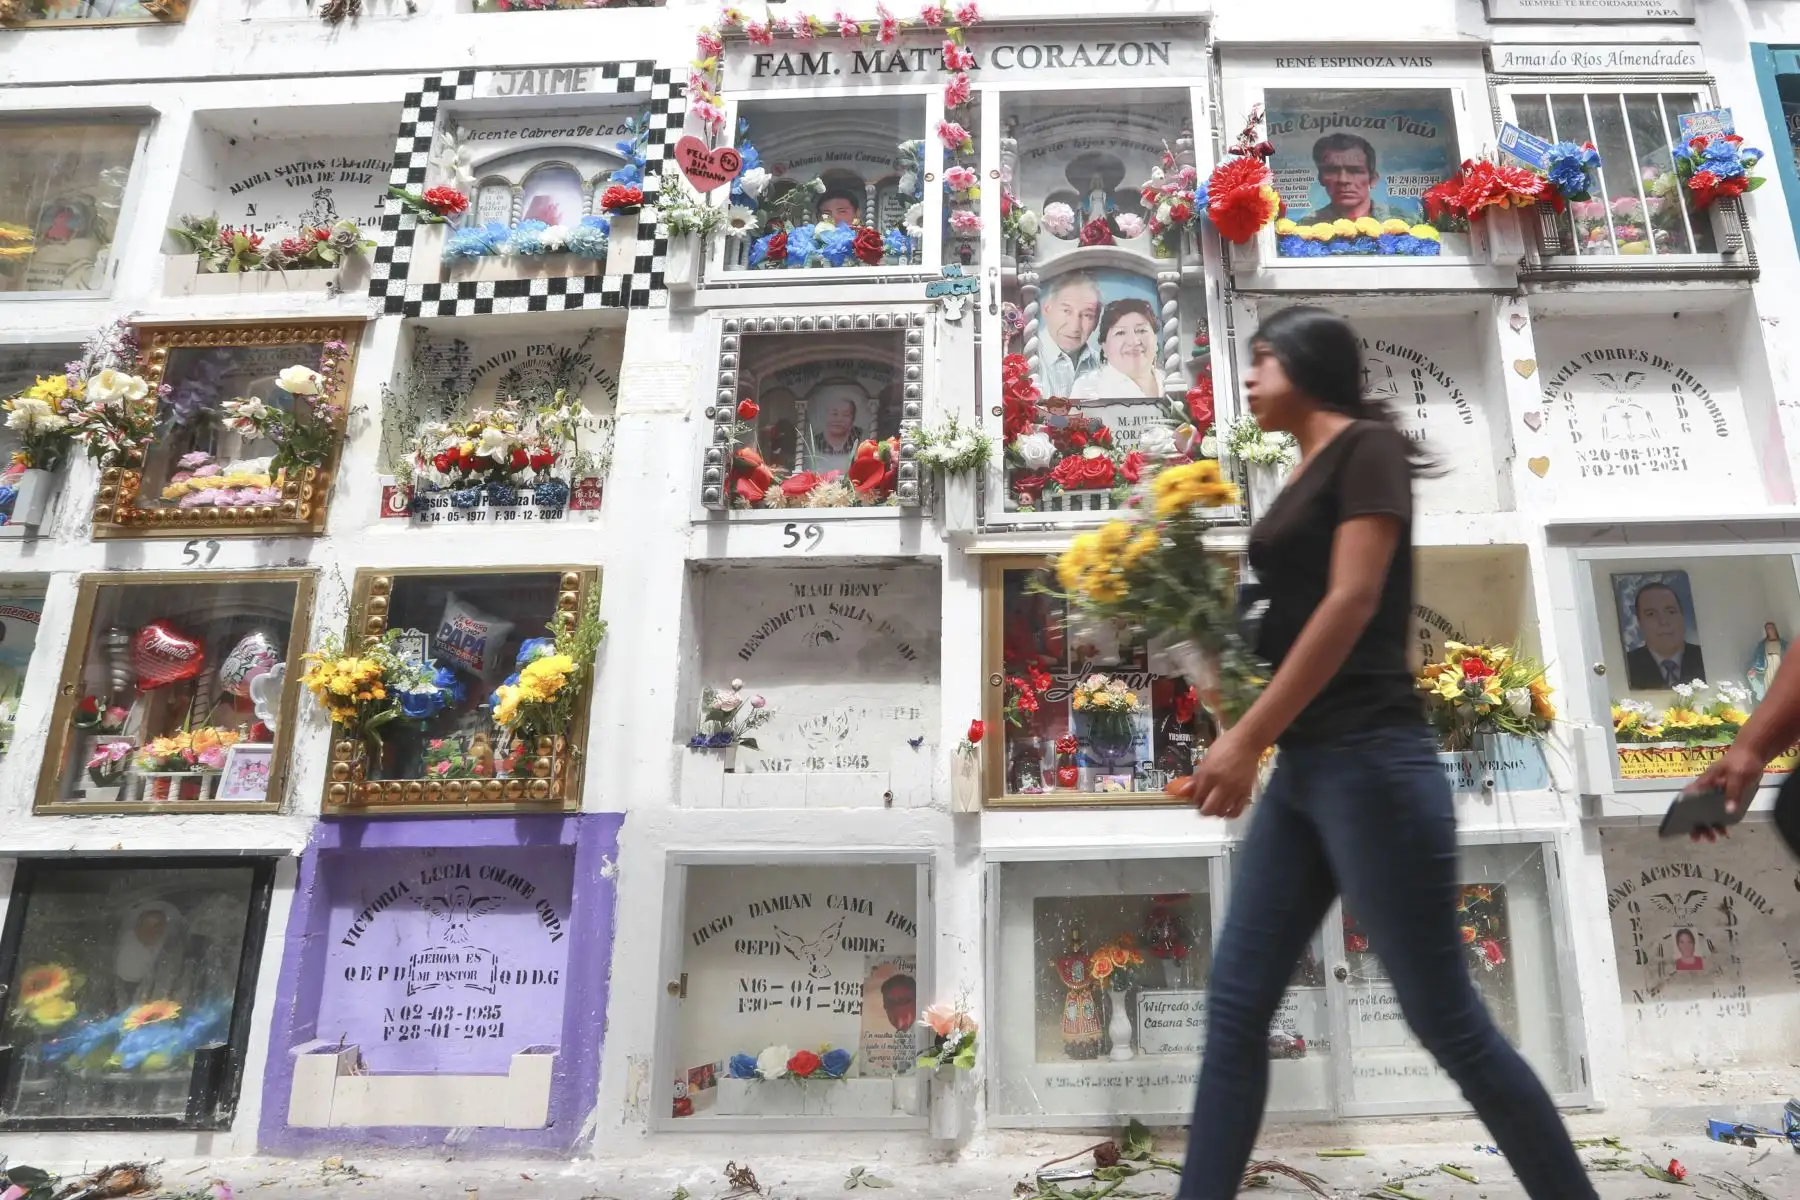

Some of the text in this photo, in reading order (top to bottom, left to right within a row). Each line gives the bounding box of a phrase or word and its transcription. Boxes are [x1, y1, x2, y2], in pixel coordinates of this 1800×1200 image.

[751, 42, 1172, 77] FAM. MATT CORAZON
[1275, 56, 1433, 68] RENÉ ESPINOZA VAIS
[1604, 51, 1696, 68] Almendrades
[519, 125, 576, 140] Cabrera
[576, 124, 594, 137] De
[596, 124, 613, 137] La
[1299, 111, 1387, 133] Espinoza
[1391, 114, 1437, 139] Vais
[477, 348, 517, 378] DAVID
[1580, 348, 1649, 364] TORRES
[1650, 355, 1674, 373] DE
[1375, 338, 1475, 426] CARDENAS SOTO
[420, 513, 429, 522] N:
[430, 512, 440, 521] 14
[447, 512, 459, 521] 05
[466, 511, 486, 521] 1977
[494, 511, 502, 521] F:
[503, 510, 516, 521] 30
[523, 511, 532, 520] 12
[539, 510, 562, 520] 2020
[737, 601, 874, 662] BENEDICTA SOLIS
[1640, 862, 1704, 887] ACOSTA
[341, 862, 565, 948] VICTORIA LUCIA COLQUE COPA
[691, 914, 734, 947] HUGO
[748, 892, 813, 919] DAMIAN
[825, 893, 874, 917] CAMA
[465, 953, 482, 965] ES
[734, 938, 782, 957] QEPD
[435, 968, 479, 981] PASTOR
[1143, 1001, 1190, 1013] Wilfredo
